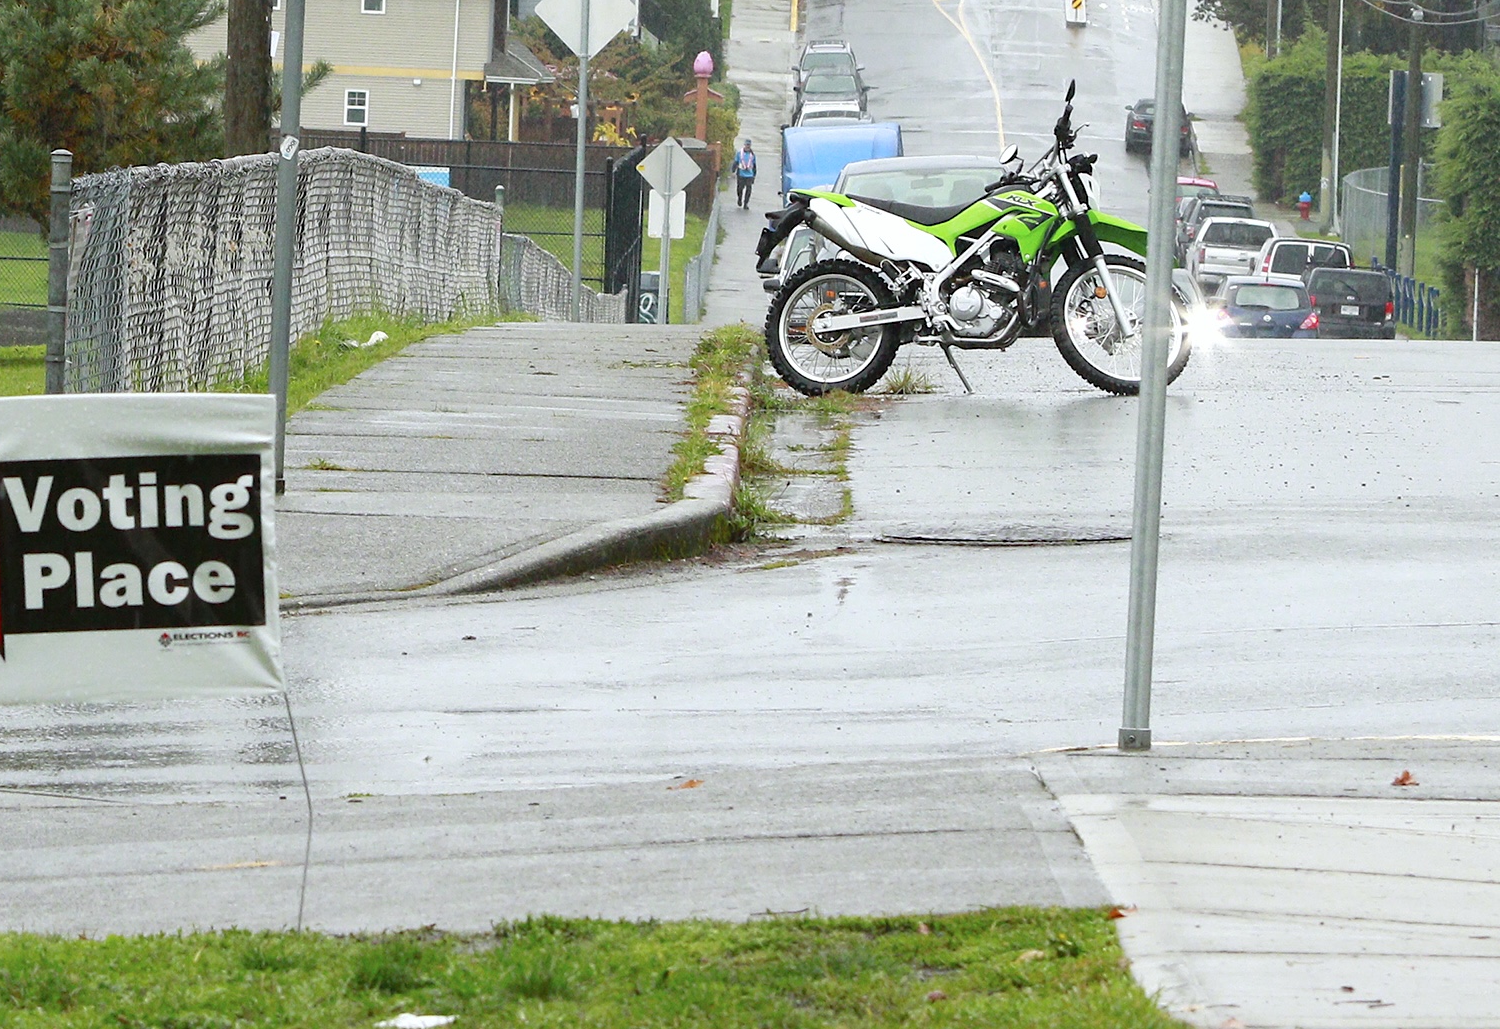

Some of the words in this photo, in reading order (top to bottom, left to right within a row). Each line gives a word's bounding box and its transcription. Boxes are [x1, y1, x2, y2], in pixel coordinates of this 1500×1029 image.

[1006, 194, 1038, 207] KLX
[2, 471, 255, 540] Voting
[22, 551, 236, 611] Place
[173, 631, 234, 641] ELECTIONS
[237, 630, 250, 638] BC
